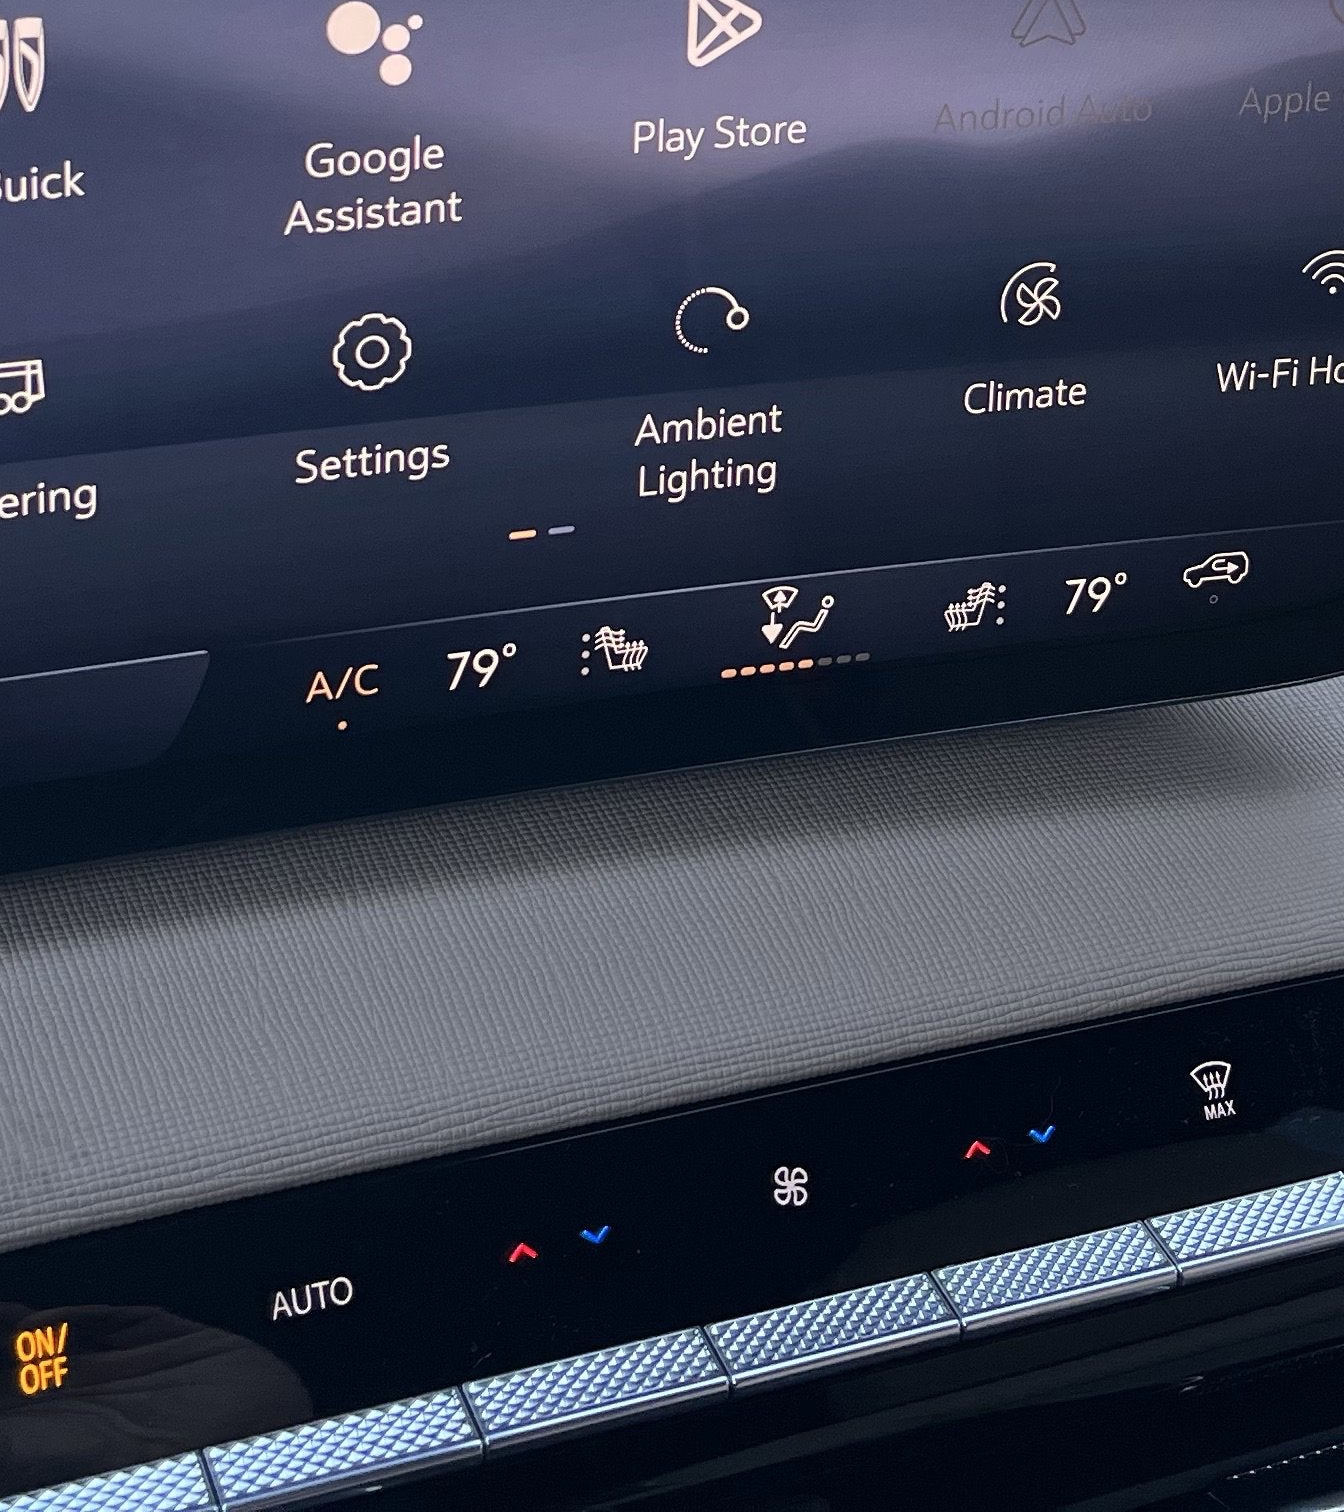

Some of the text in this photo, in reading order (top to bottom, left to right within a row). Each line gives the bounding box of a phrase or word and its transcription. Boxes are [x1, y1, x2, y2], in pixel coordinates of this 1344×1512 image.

[932, 94, 1066, 133] Android
[1238, 80, 1332, 124] Apple
[305, 134, 445, 182] Google
[633, 115, 807, 161] Play Store
[283, 191, 463, 236] Assistant
[1216, 357, 1299, 393] Wi-Fi
[964, 379, 1087, 415] Climate
[634, 404, 783, 447] Ambient
[295, 443, 450, 484] Settings
[639, 457, 777, 503] Lighting
[1065, 571, 1127, 615] 79°
[305, 663, 379, 704] A/C
[447, 642, 517, 691] 79°
[1203, 1099, 1237, 1121] MAX
[272, 1276, 353, 1321] AUTO
[16, 1322, 68, 1359] ON/
[18, 1357, 68, 1395] OFF
